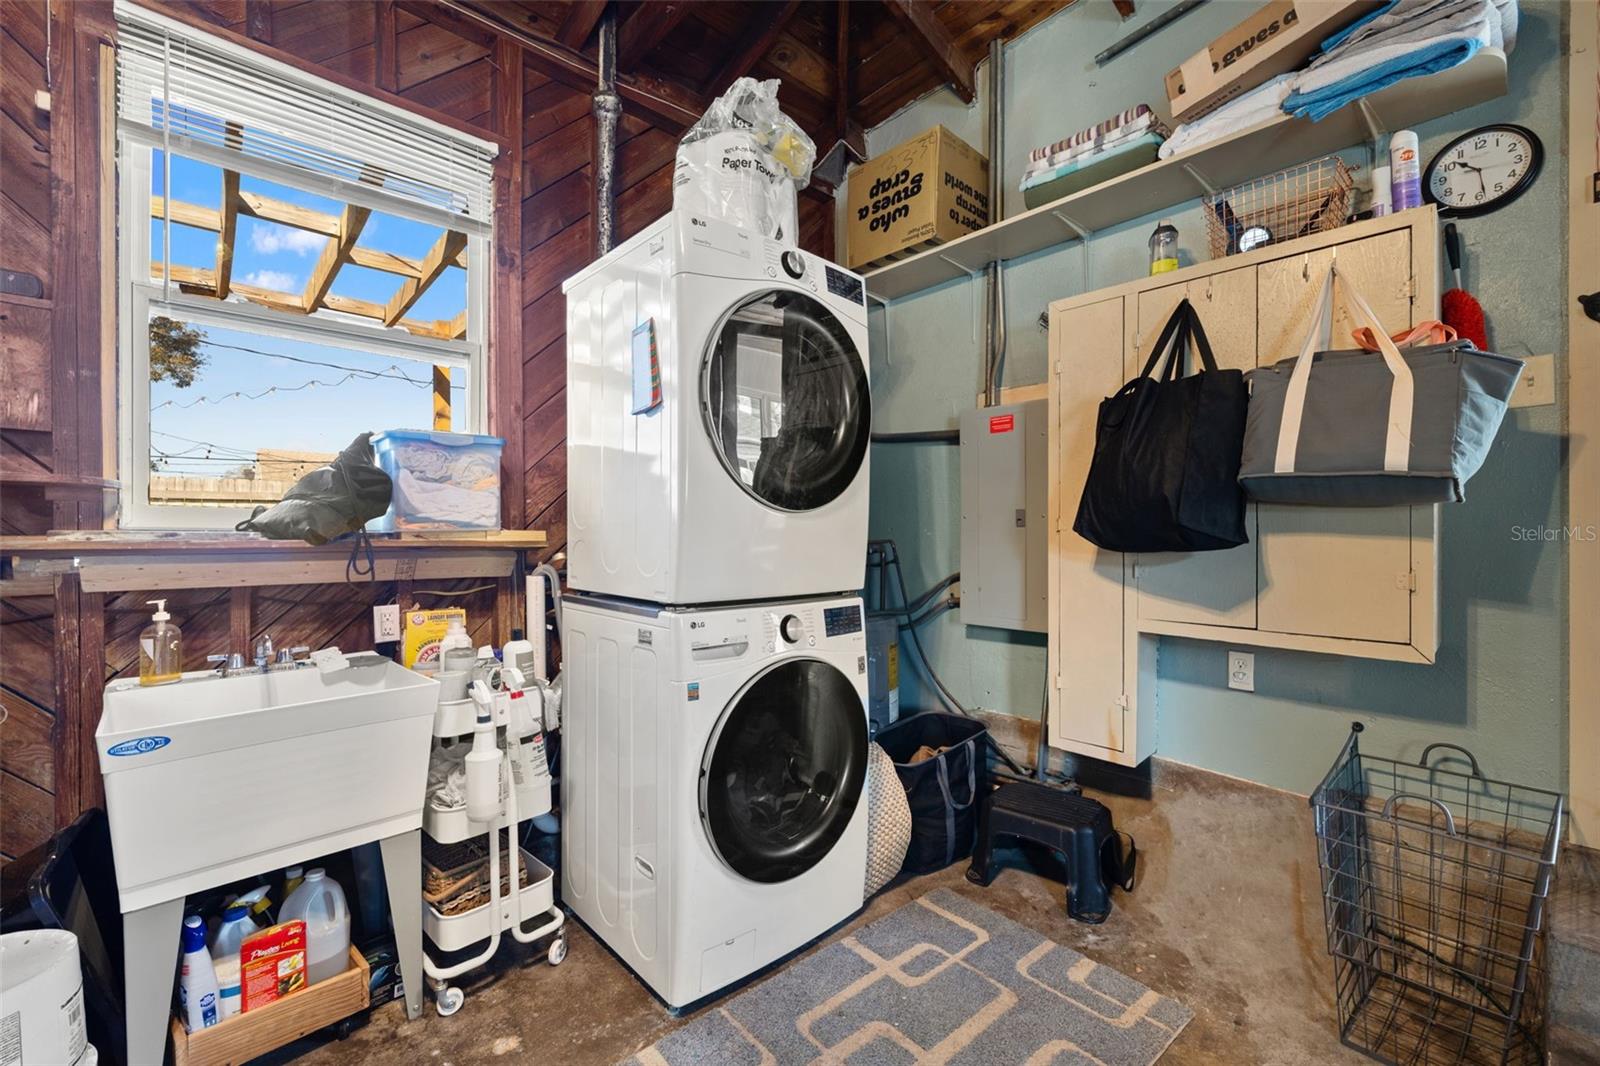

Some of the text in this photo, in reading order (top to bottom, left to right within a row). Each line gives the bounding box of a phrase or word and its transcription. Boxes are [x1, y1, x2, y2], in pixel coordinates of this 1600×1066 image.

[1222, 19, 1280, 68] gives
[1474, 139, 1487, 150] 12
[1495, 137, 1500, 147] 1
[1507, 142, 1517, 153] 2
[1457, 149, 1464, 159] 11
[1513, 154, 1523, 164] 3
[721, 157, 752, 171] Paper
[1443, 162, 1456, 173] 10
[1507, 169, 1517, 178] 4
[869, 169, 910, 199] crap
[944, 172, 973, 198] world
[1438, 176, 1447, 185] 9
[1444, 187, 1453, 197] 8
[1494, 182, 1503, 192] 5
[857, 172, 924, 221] gives a
[1457, 192, 1466, 202] 7
[1474, 191, 1484, 201] 6
[869, 204, 910, 233] who
[949, 208, 960, 225] to
